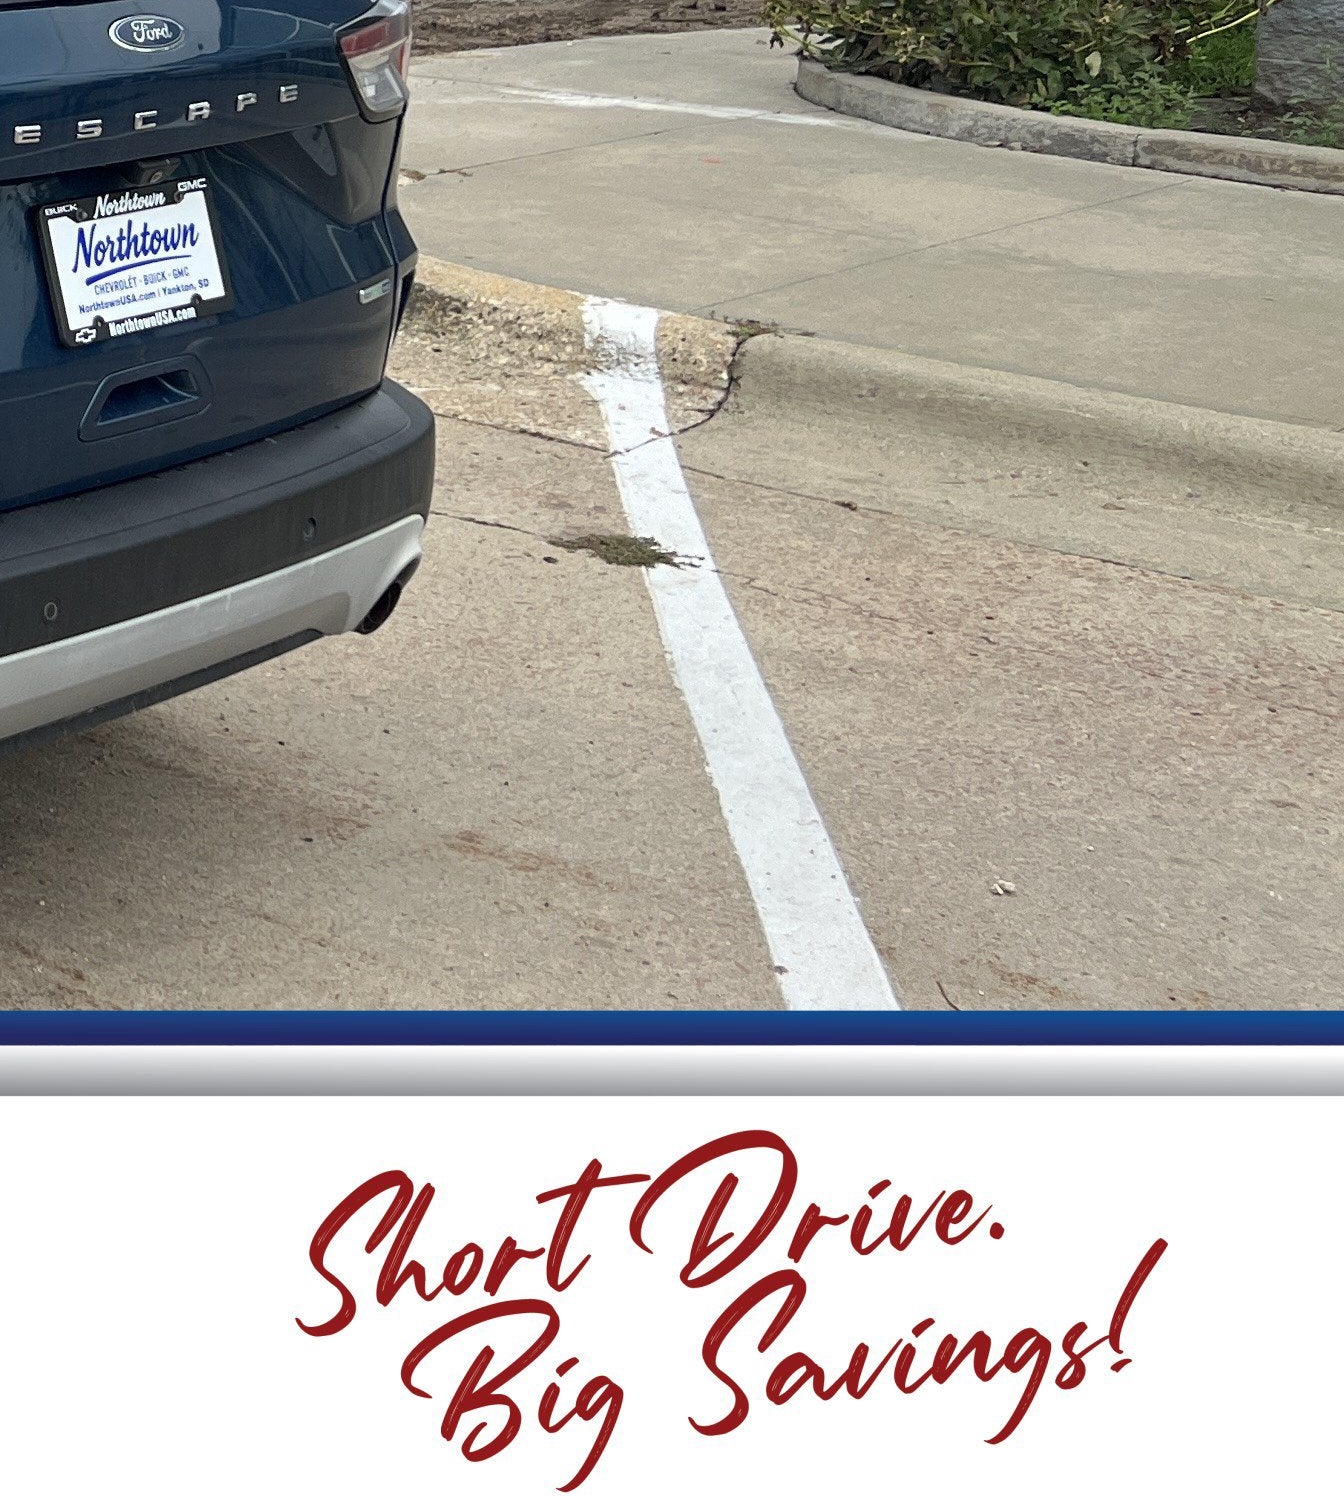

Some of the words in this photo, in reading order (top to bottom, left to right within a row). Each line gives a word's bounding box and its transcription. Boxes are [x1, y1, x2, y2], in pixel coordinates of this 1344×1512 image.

[131, 19, 173, 42] Ford
[14, 84, 299, 145] ESCAPE
[177, 178, 207, 192] GMC
[45, 203, 78, 217] BUICK
[93, 192, 166, 220] Northtown
[72, 219, 200, 273] Northtown
[143, 271, 168, 286] BUICK
[172, 267, 190, 279] GMC
[79, 292, 157, 314] NorthtownUSA.com
[198, 278, 210, 289] SD
[108, 307, 197, 337] NorthtownUSA.com
